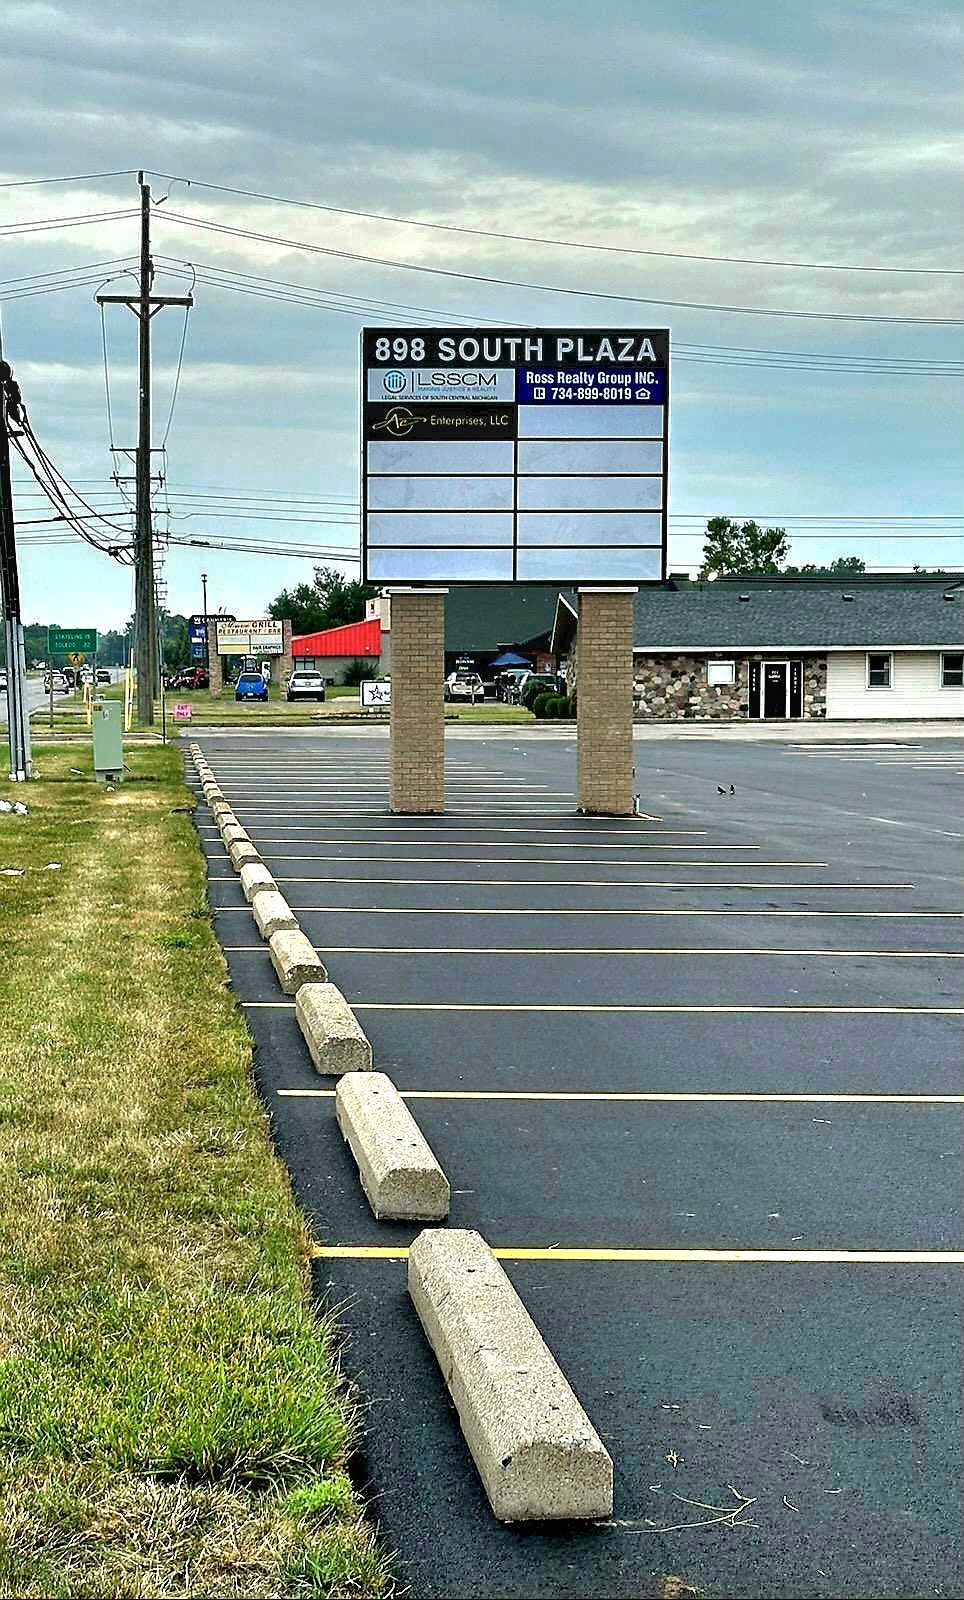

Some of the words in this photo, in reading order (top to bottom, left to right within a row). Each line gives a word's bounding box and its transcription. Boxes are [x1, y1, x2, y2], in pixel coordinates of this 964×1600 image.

[375, 337, 426, 361] 898
[438, 337, 543, 362] SOUTH
[557, 337, 657, 361] PLAZA
[417, 372, 497, 386] LSSCM
[526, 371, 554, 384] Ross
[557, 371, 594, 386] Realty
[598, 371, 631, 386] Group
[634, 371, 659, 384] INC.
[551, 387, 632, 400] 734-899-8019
[430, 415, 487, 426] Enterprises,
[490, 415, 509, 425] LLC
